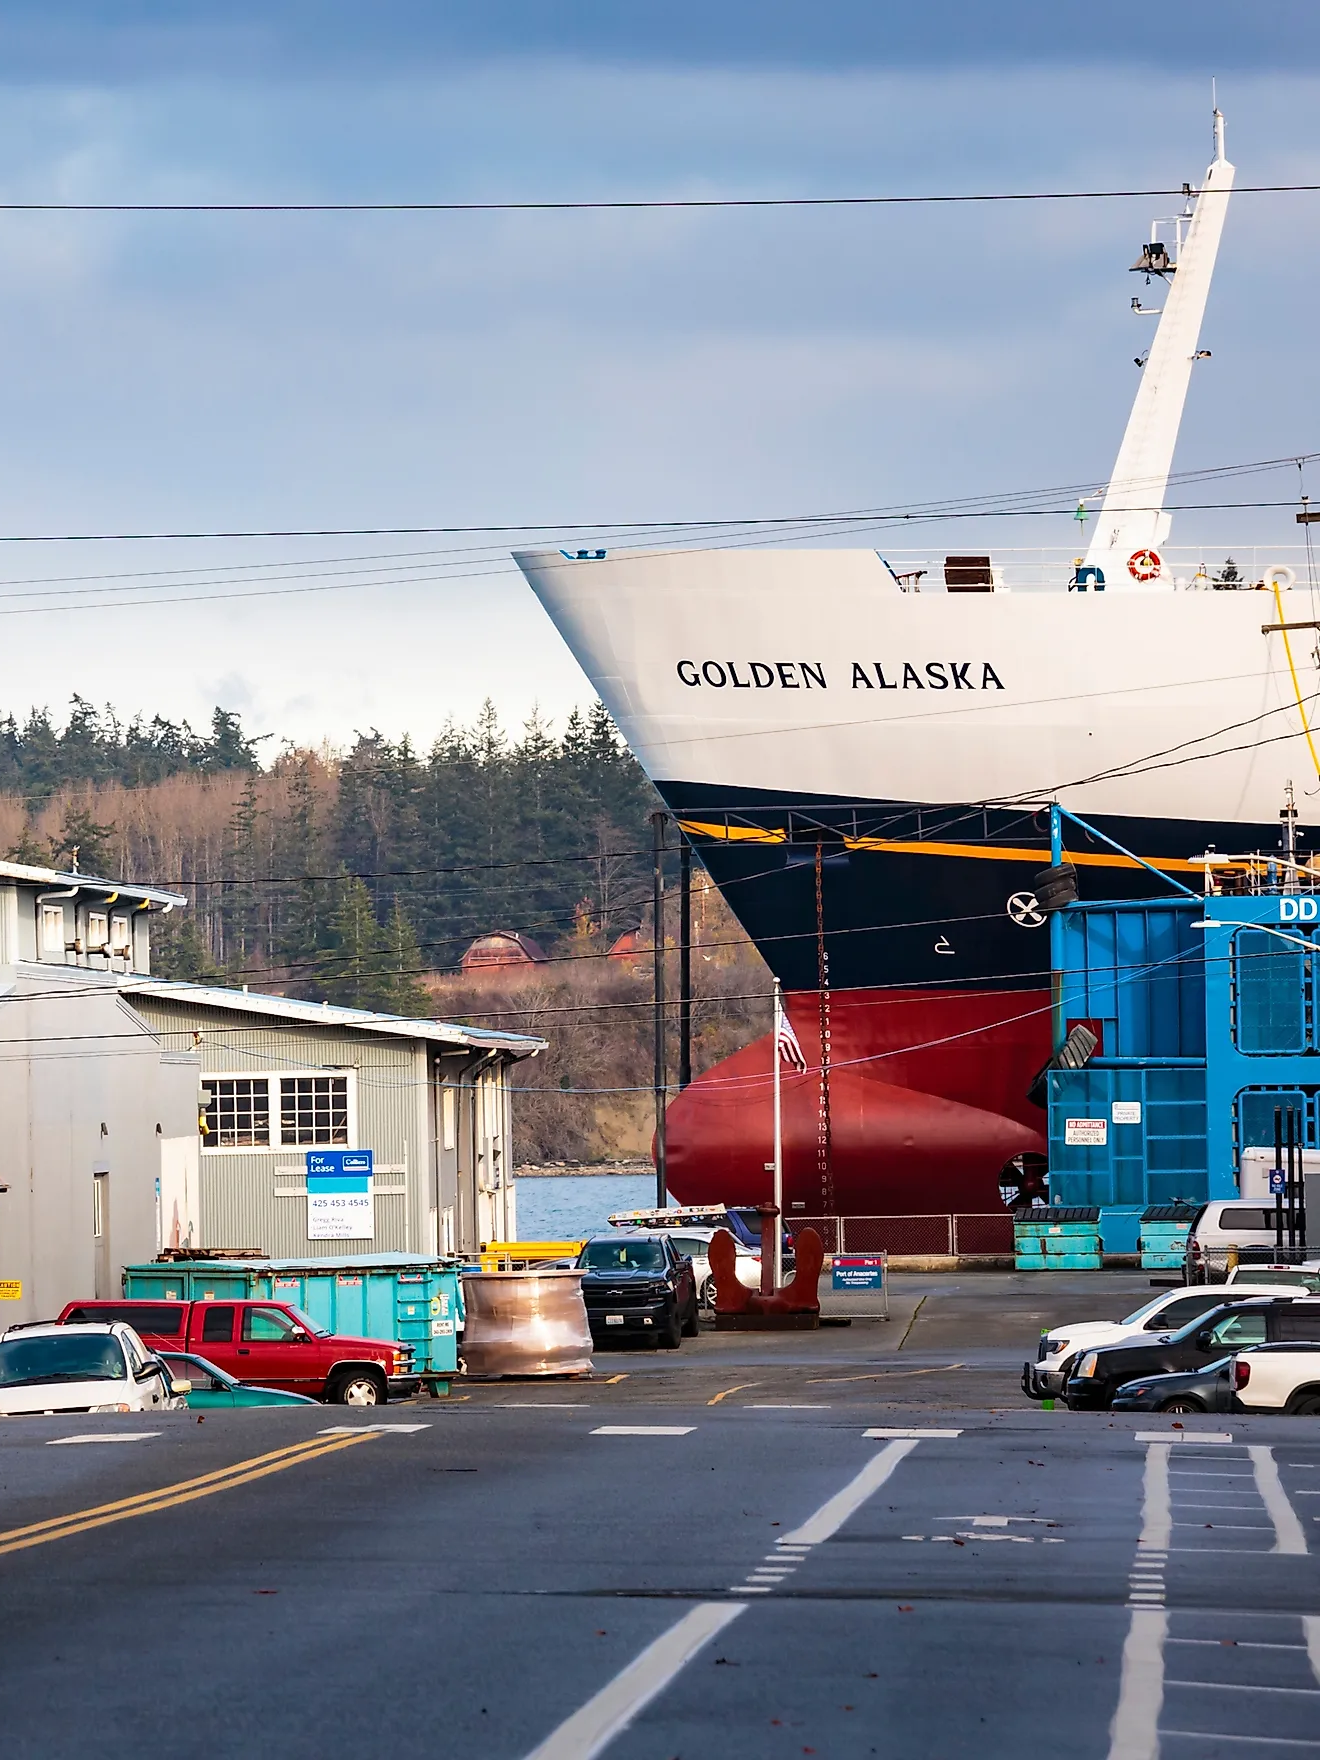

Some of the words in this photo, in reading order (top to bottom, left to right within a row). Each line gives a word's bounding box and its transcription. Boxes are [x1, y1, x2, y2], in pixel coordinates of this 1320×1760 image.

[676, 659, 827, 689] GOLDEN
[851, 661, 1006, 690] ALASKA
[1280, 898, 1318, 920] DD
[817, 1136, 827, 1144] 12
[311, 1156, 325, 1164] For
[310, 1164, 335, 1173] Lease
[348, 1199, 370, 1207] 4545
